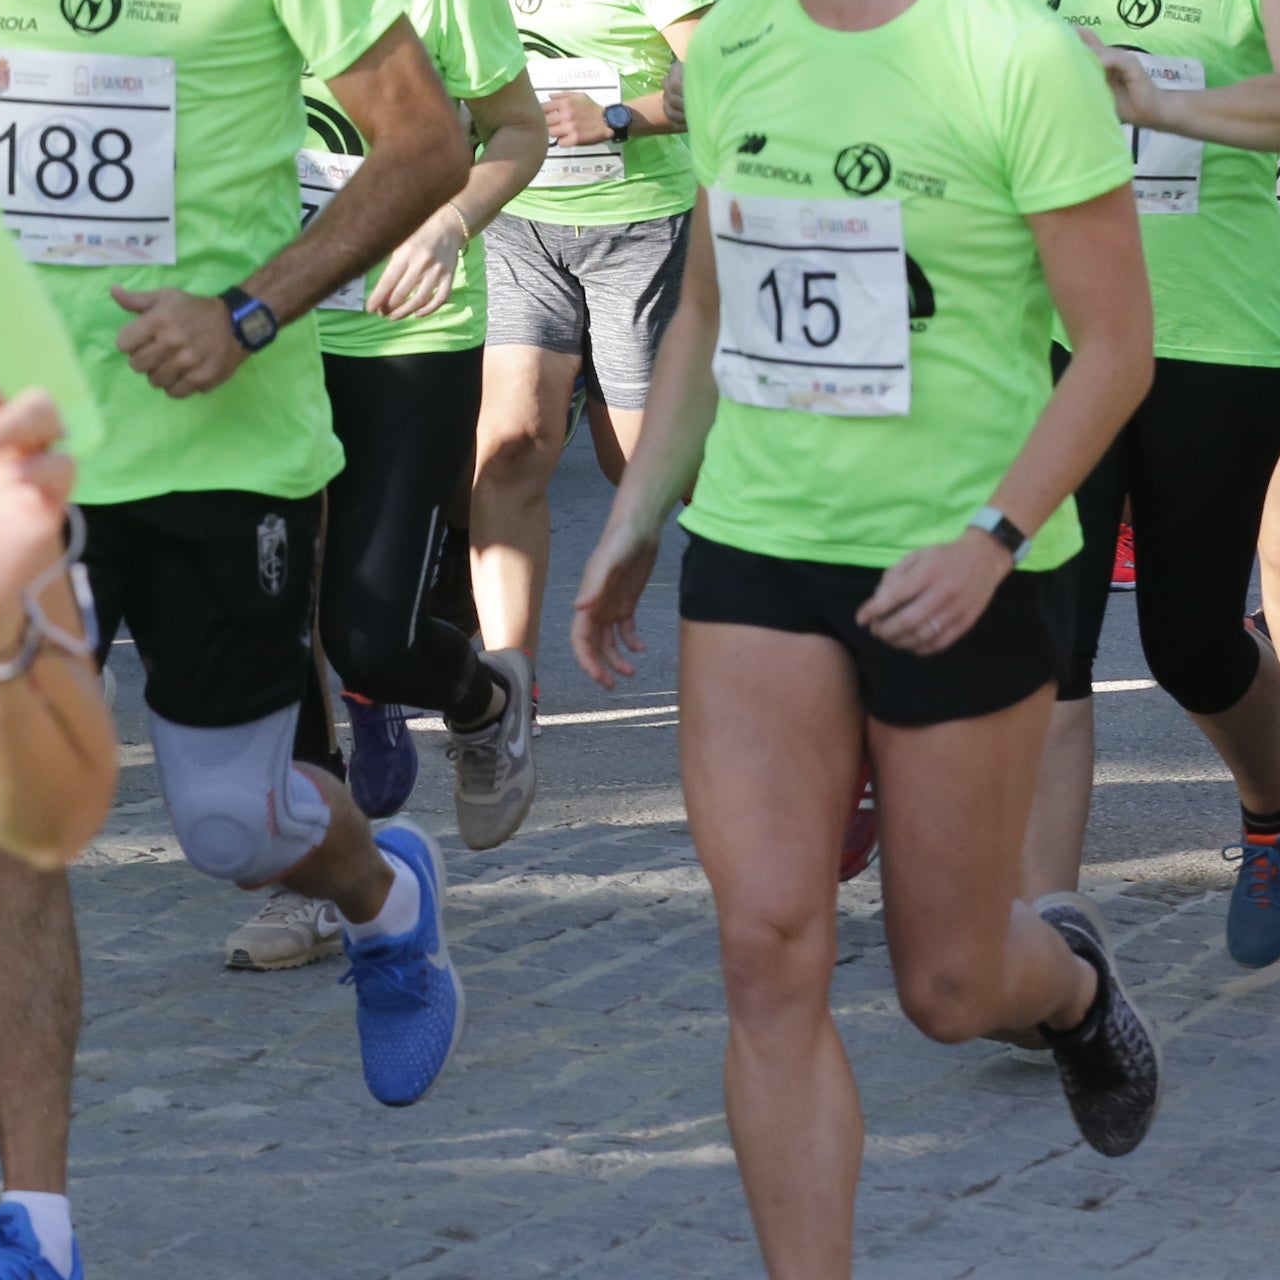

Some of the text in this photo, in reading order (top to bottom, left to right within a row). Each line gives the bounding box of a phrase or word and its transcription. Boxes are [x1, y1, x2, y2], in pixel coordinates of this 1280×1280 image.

[1163, 11, 1201, 24] MUJER
[736, 159, 813, 187] IBERDROLA
[759, 269, 841, 348] 15
